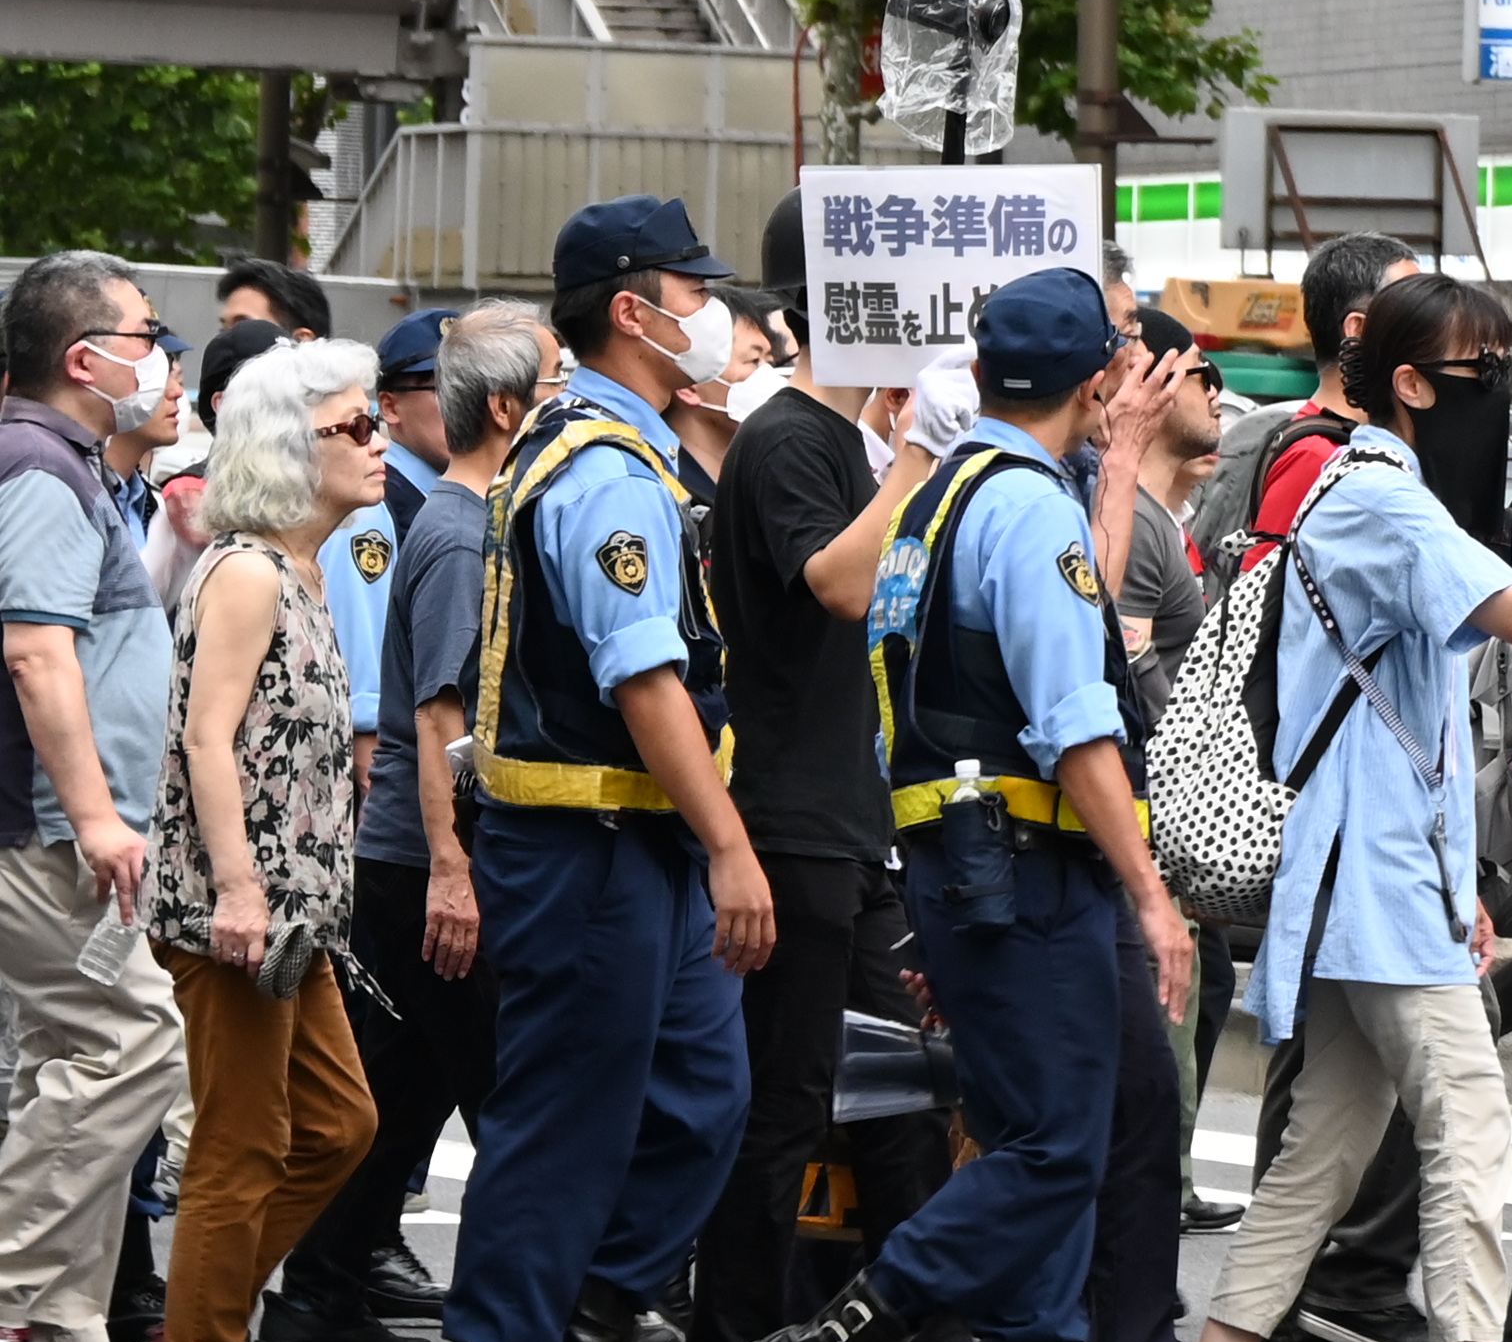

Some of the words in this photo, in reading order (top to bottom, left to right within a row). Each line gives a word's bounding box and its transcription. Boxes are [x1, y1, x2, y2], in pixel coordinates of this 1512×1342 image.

[822, 193, 1078, 258] 戦争準備の
